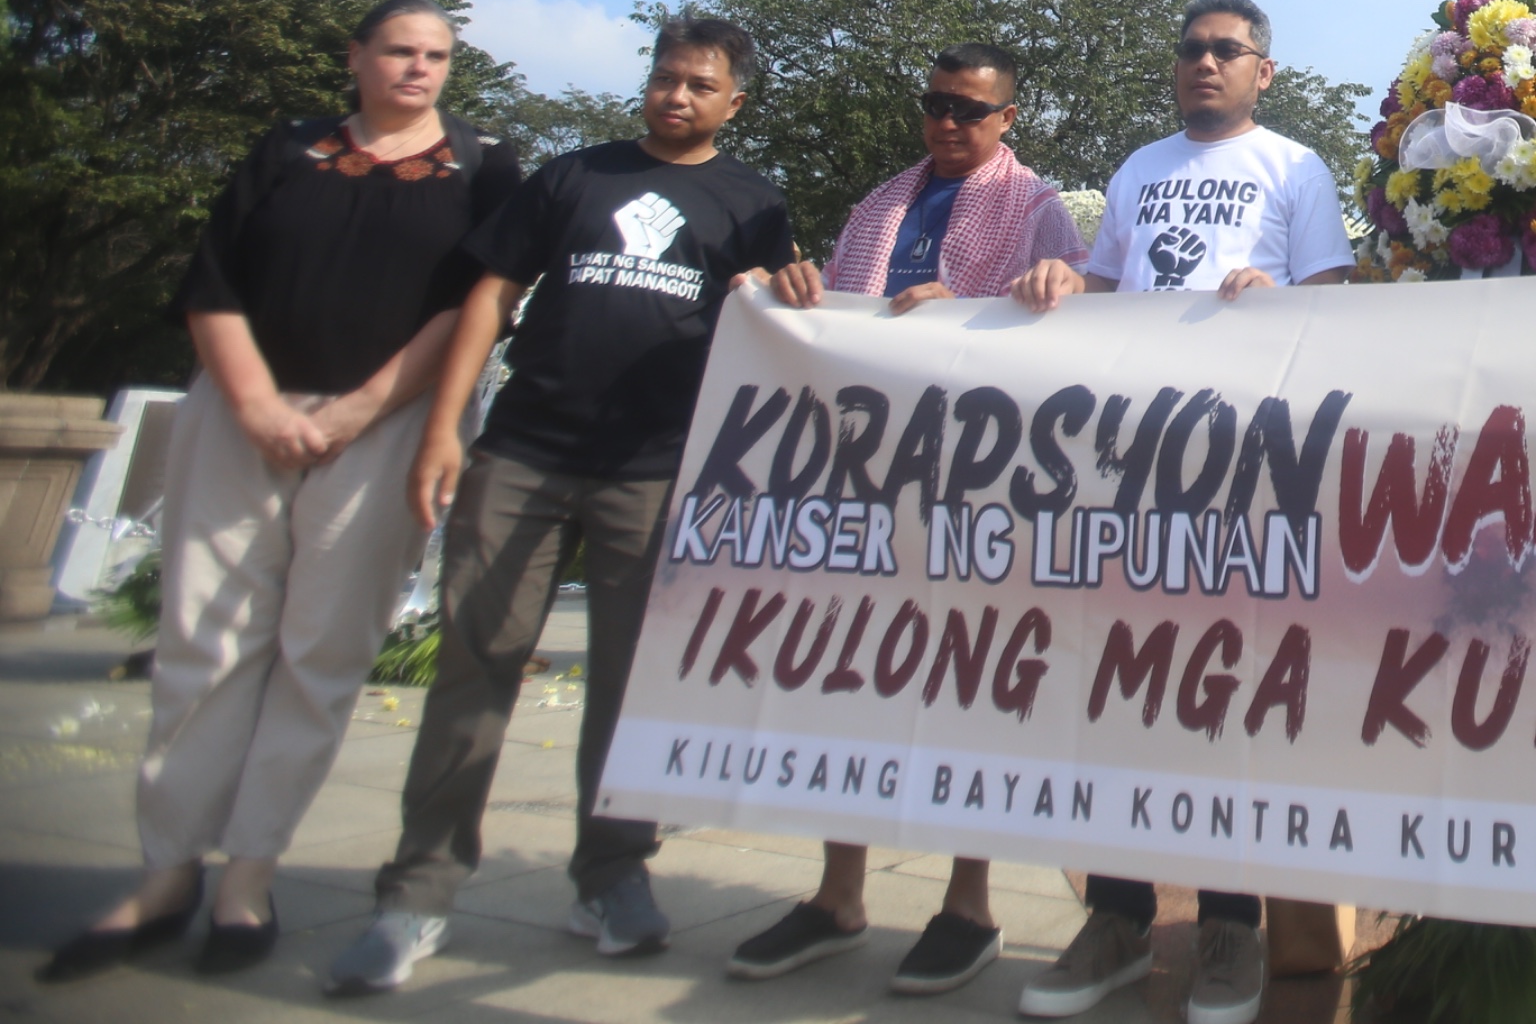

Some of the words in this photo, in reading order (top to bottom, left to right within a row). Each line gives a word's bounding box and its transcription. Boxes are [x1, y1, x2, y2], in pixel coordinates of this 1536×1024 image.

[1136, 202, 1171, 226] NA
[1182, 202, 1245, 228] YAN!
[1137, 178, 1259, 206] IKULONG
[613, 254, 635, 269] NG
[637, 259, 704, 285] SANGKOT,
[614, 270, 702, 302] MANAGOT!
[696, 383, 1354, 528] KORAPSYON
[667, 493, 899, 574] KANSER
[924, 501, 1015, 585] NG
[1030, 506, 1323, 599] LIPUNAN
[678, 587, 1053, 724] IKULONG
[1087, 617, 1313, 745] MGA
[665, 738, 901, 800] KILUSANG
[930, 764, 1094, 823] BAYAN
[1130, 787, 1354, 854] KONTRA
